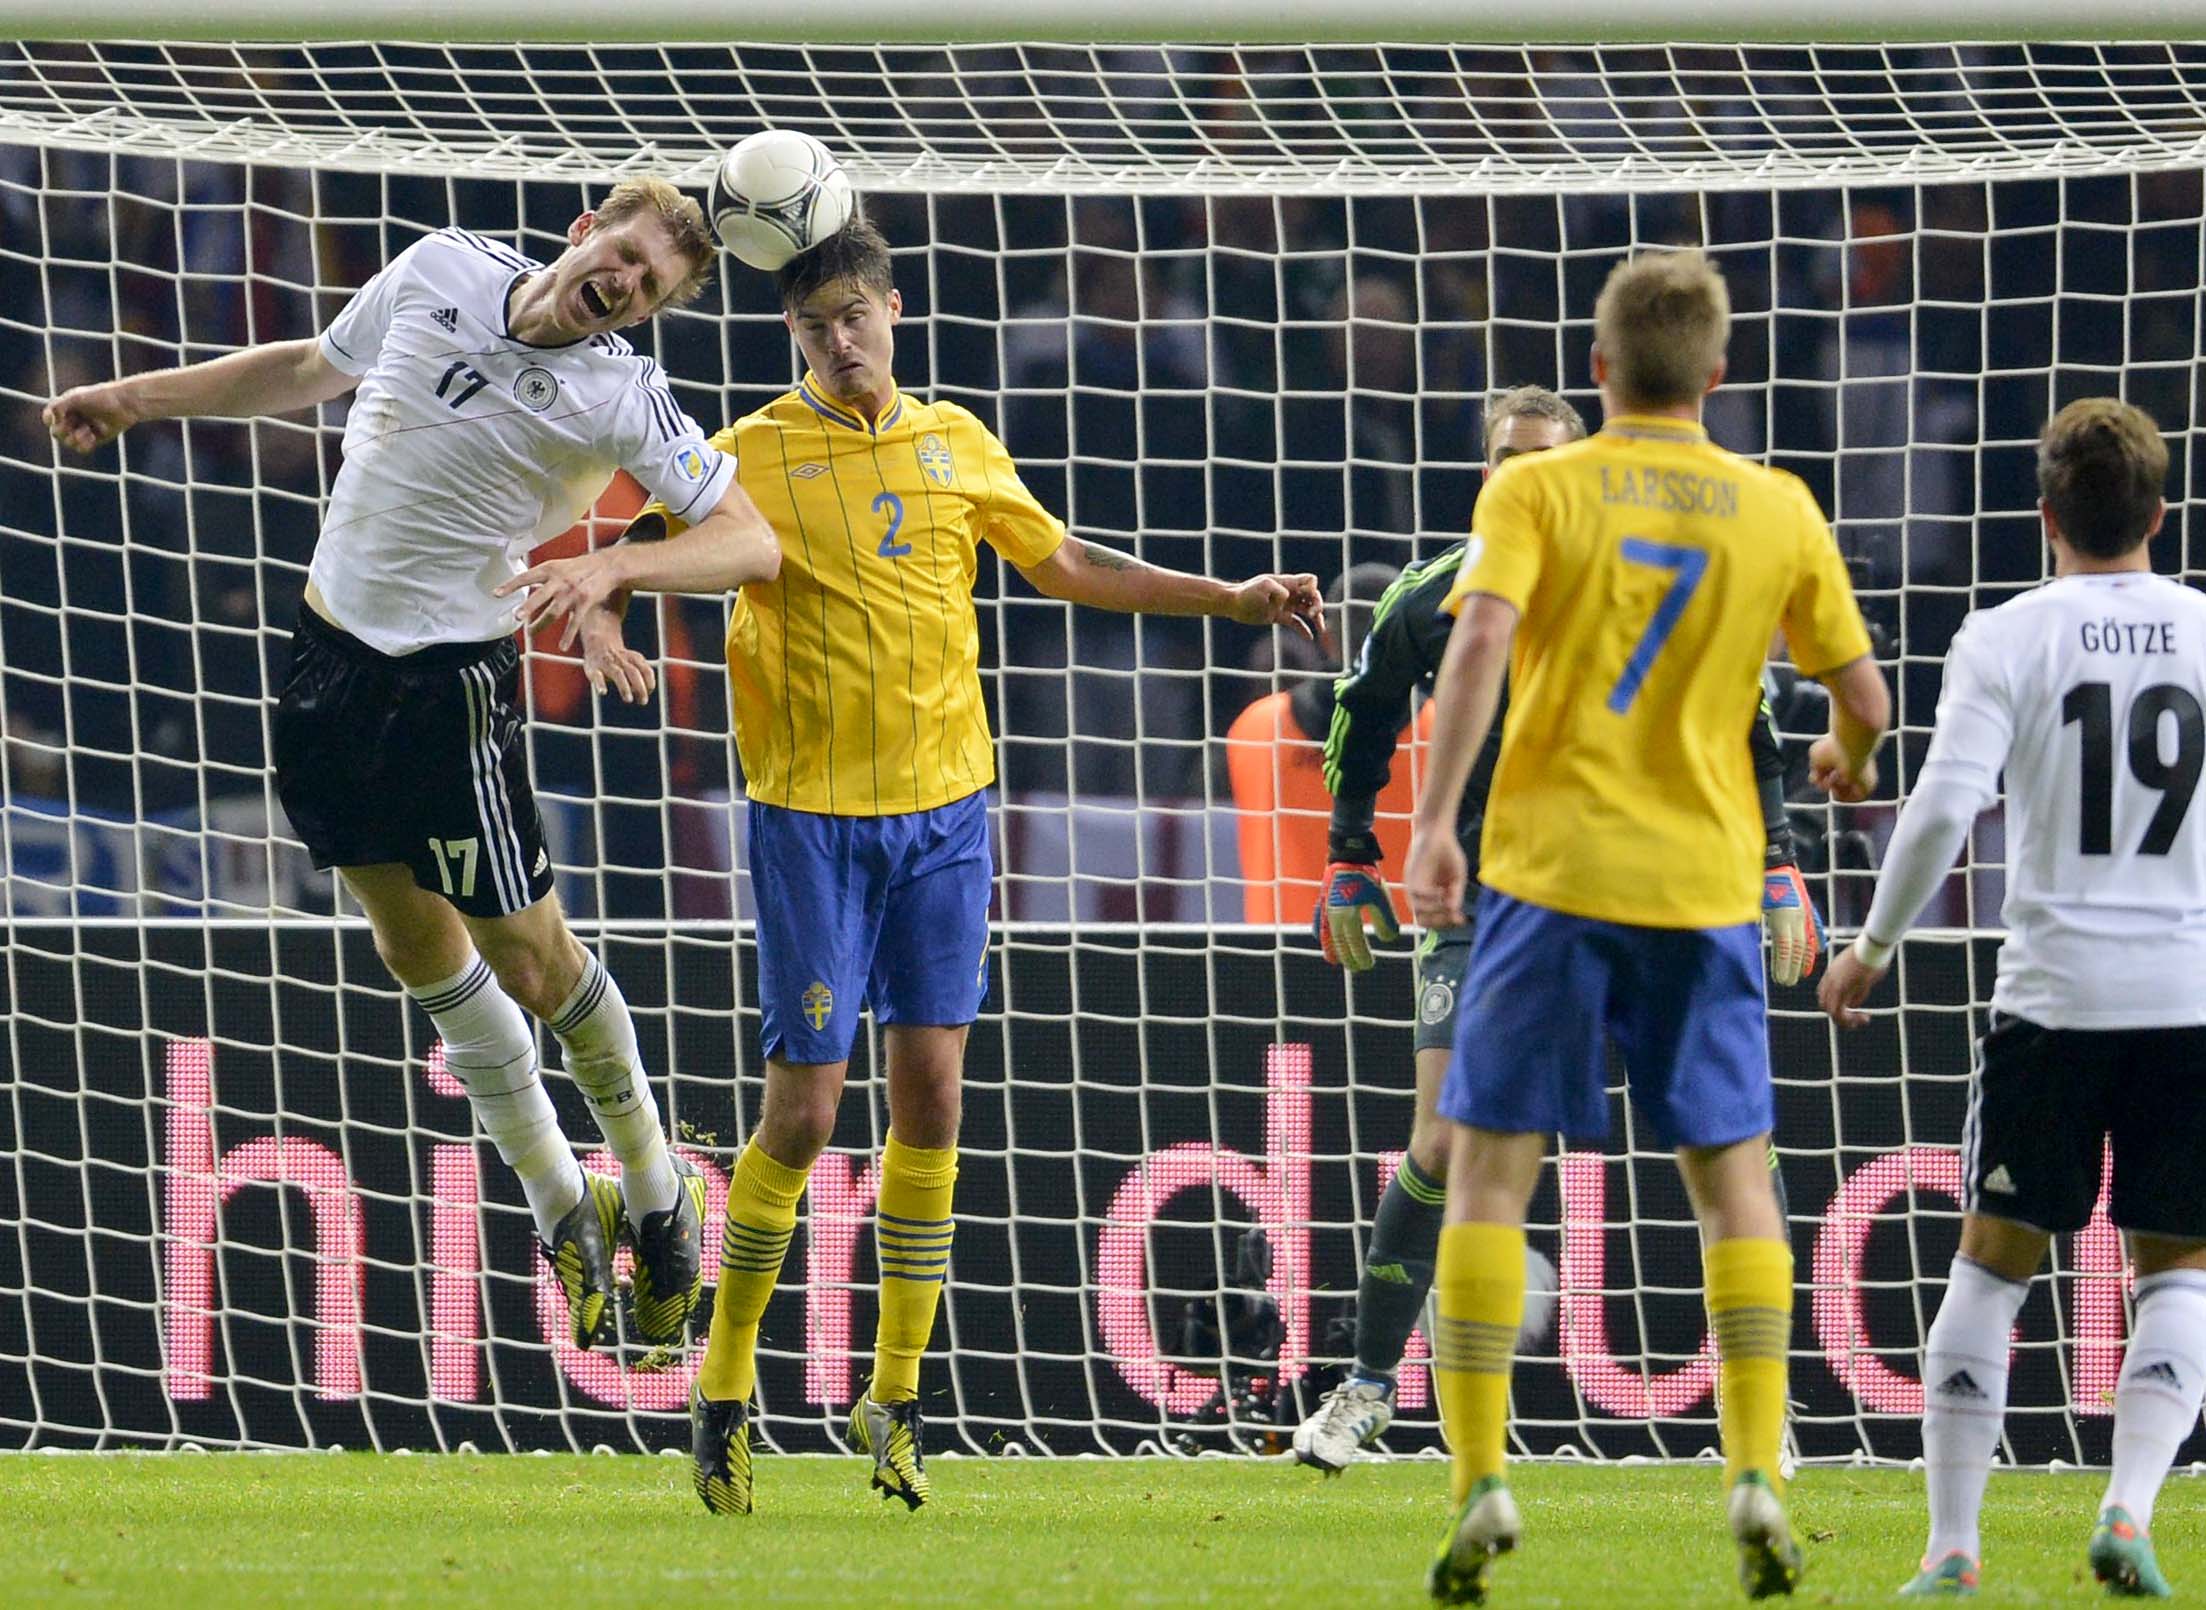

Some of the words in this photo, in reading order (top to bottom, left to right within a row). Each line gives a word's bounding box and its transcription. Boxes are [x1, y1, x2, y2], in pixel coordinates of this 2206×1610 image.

[435, 361, 490, 410] 17
[1600, 466, 1740, 519] LARSSON
[871, 492, 912, 558] 2
[1606, 537, 1710, 717] 7
[2081, 617, 2177, 655] GÖTZE
[2062, 682, 2205, 856] 19
[428, 837, 479, 897] 17
